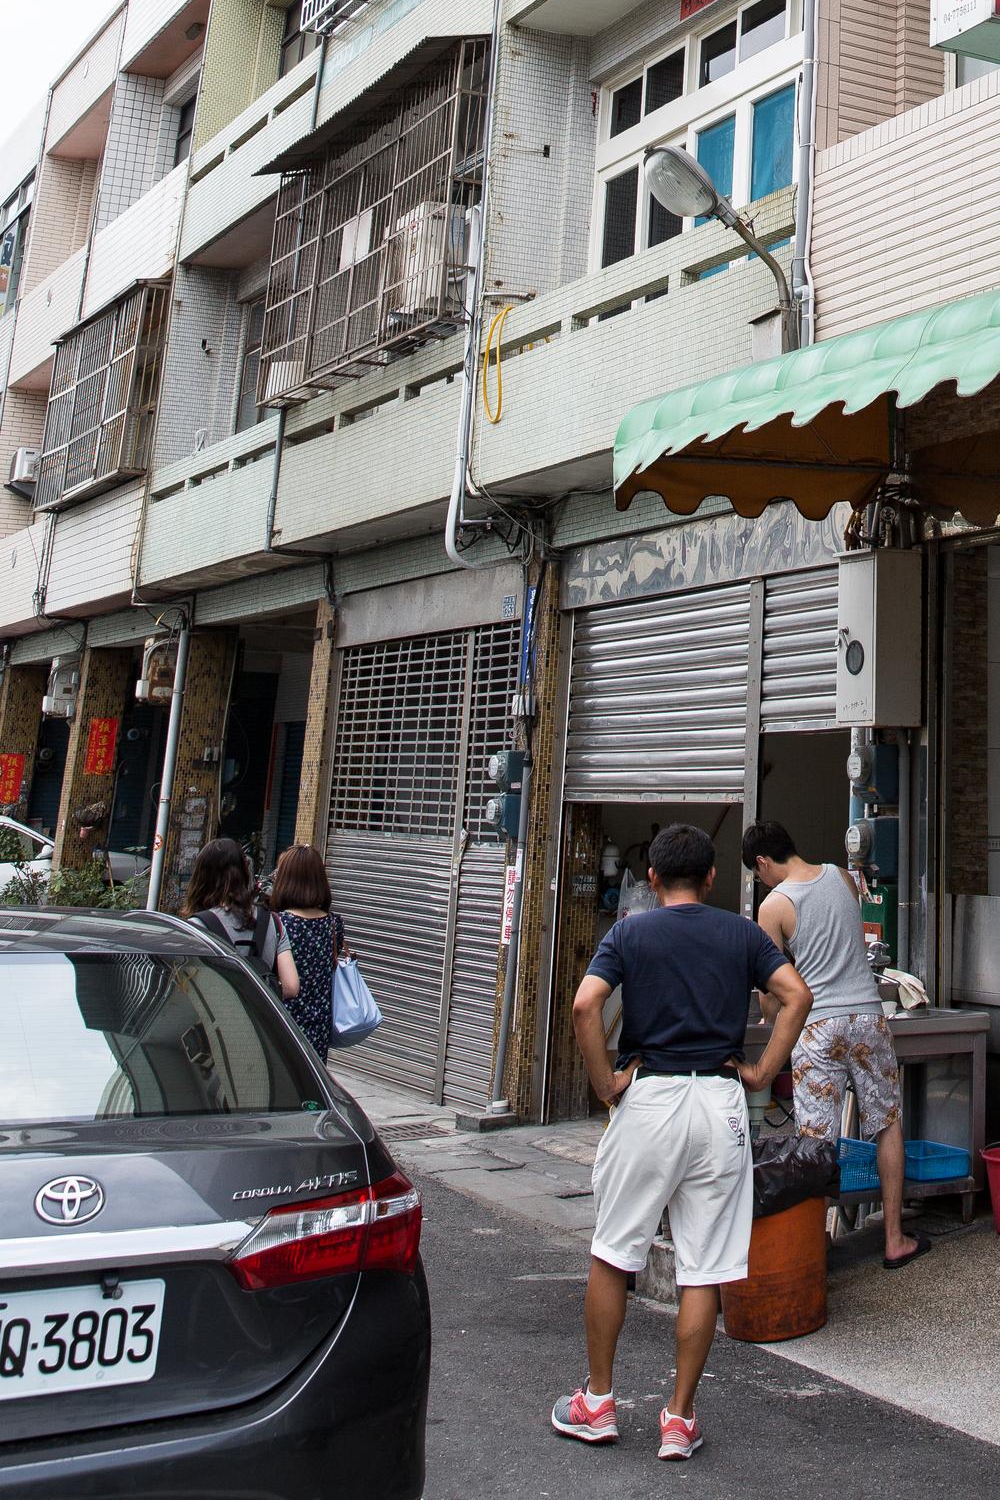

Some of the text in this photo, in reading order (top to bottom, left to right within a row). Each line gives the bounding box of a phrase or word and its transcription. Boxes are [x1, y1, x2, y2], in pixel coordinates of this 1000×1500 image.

[232, 1171, 358, 1200] COROLLA ALTIS
[0, 1304, 156, 1378] Q-3803
